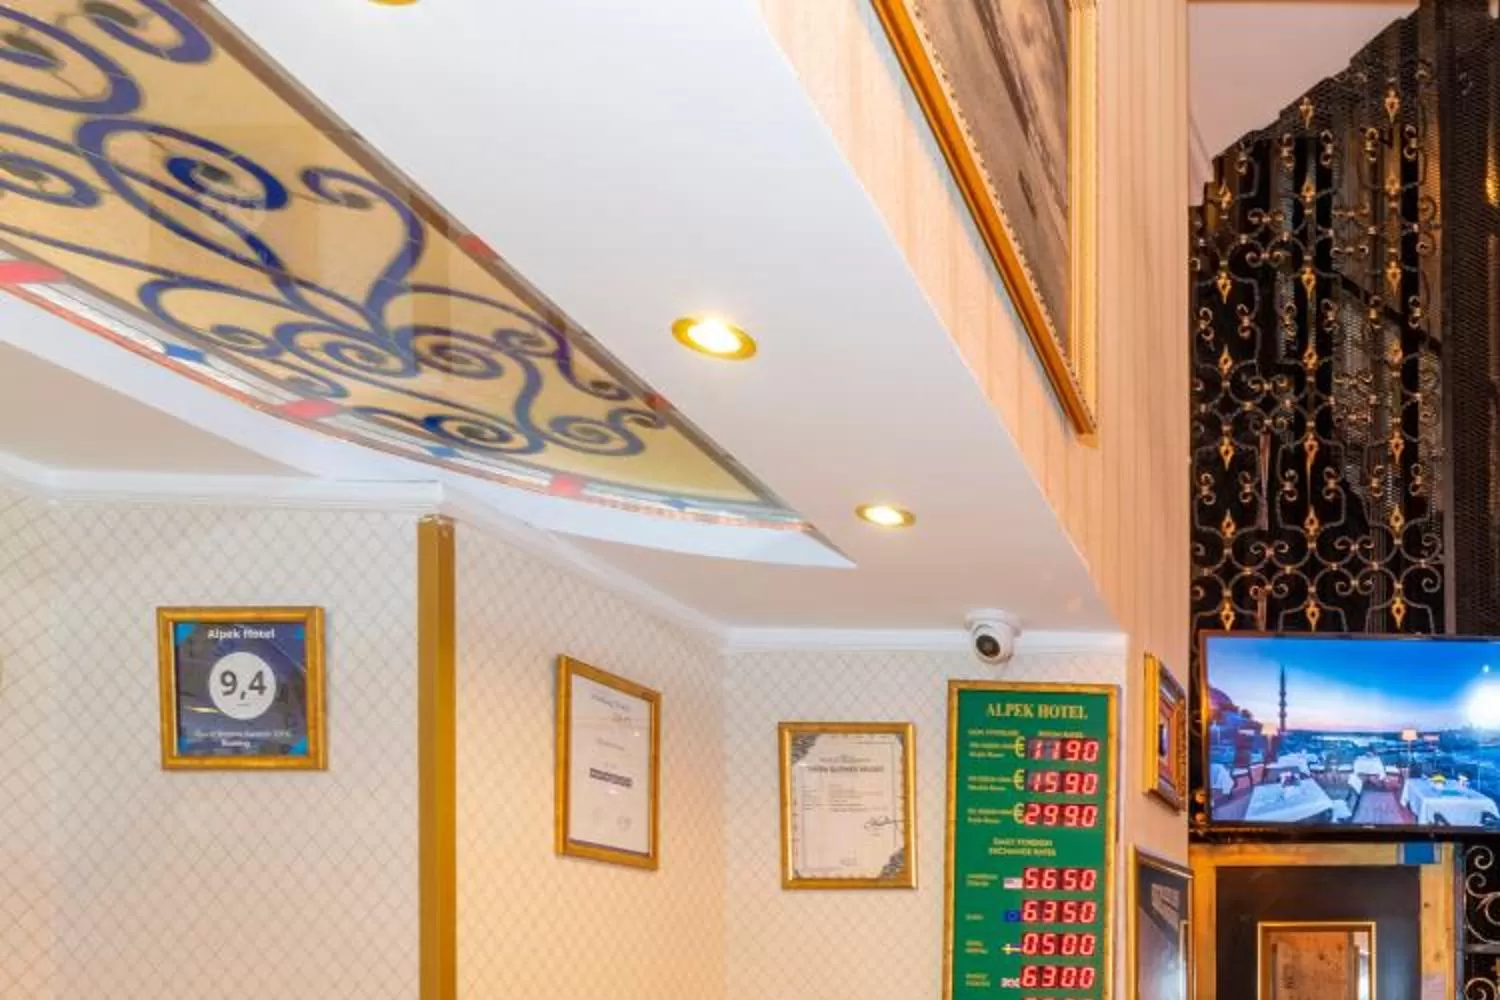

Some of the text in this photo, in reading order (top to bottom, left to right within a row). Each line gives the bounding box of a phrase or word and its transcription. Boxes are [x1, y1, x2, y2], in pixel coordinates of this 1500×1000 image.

[207, 628, 275, 640] Alpek Hotel
[220, 670, 267, 700] 9,4
[986, 703, 1088, 720] ALPEK HOTEL
[1034, 740, 1100, 762] 1190
[1032, 772, 1098, 795] 1590
[1024, 804, 1098, 827] 2990
[1025, 868, 1097, 891] 5650
[1024, 901, 1097, 923] 6350
[1024, 933, 1097, 955] 0500
[1022, 966, 1096, 988] 6300
